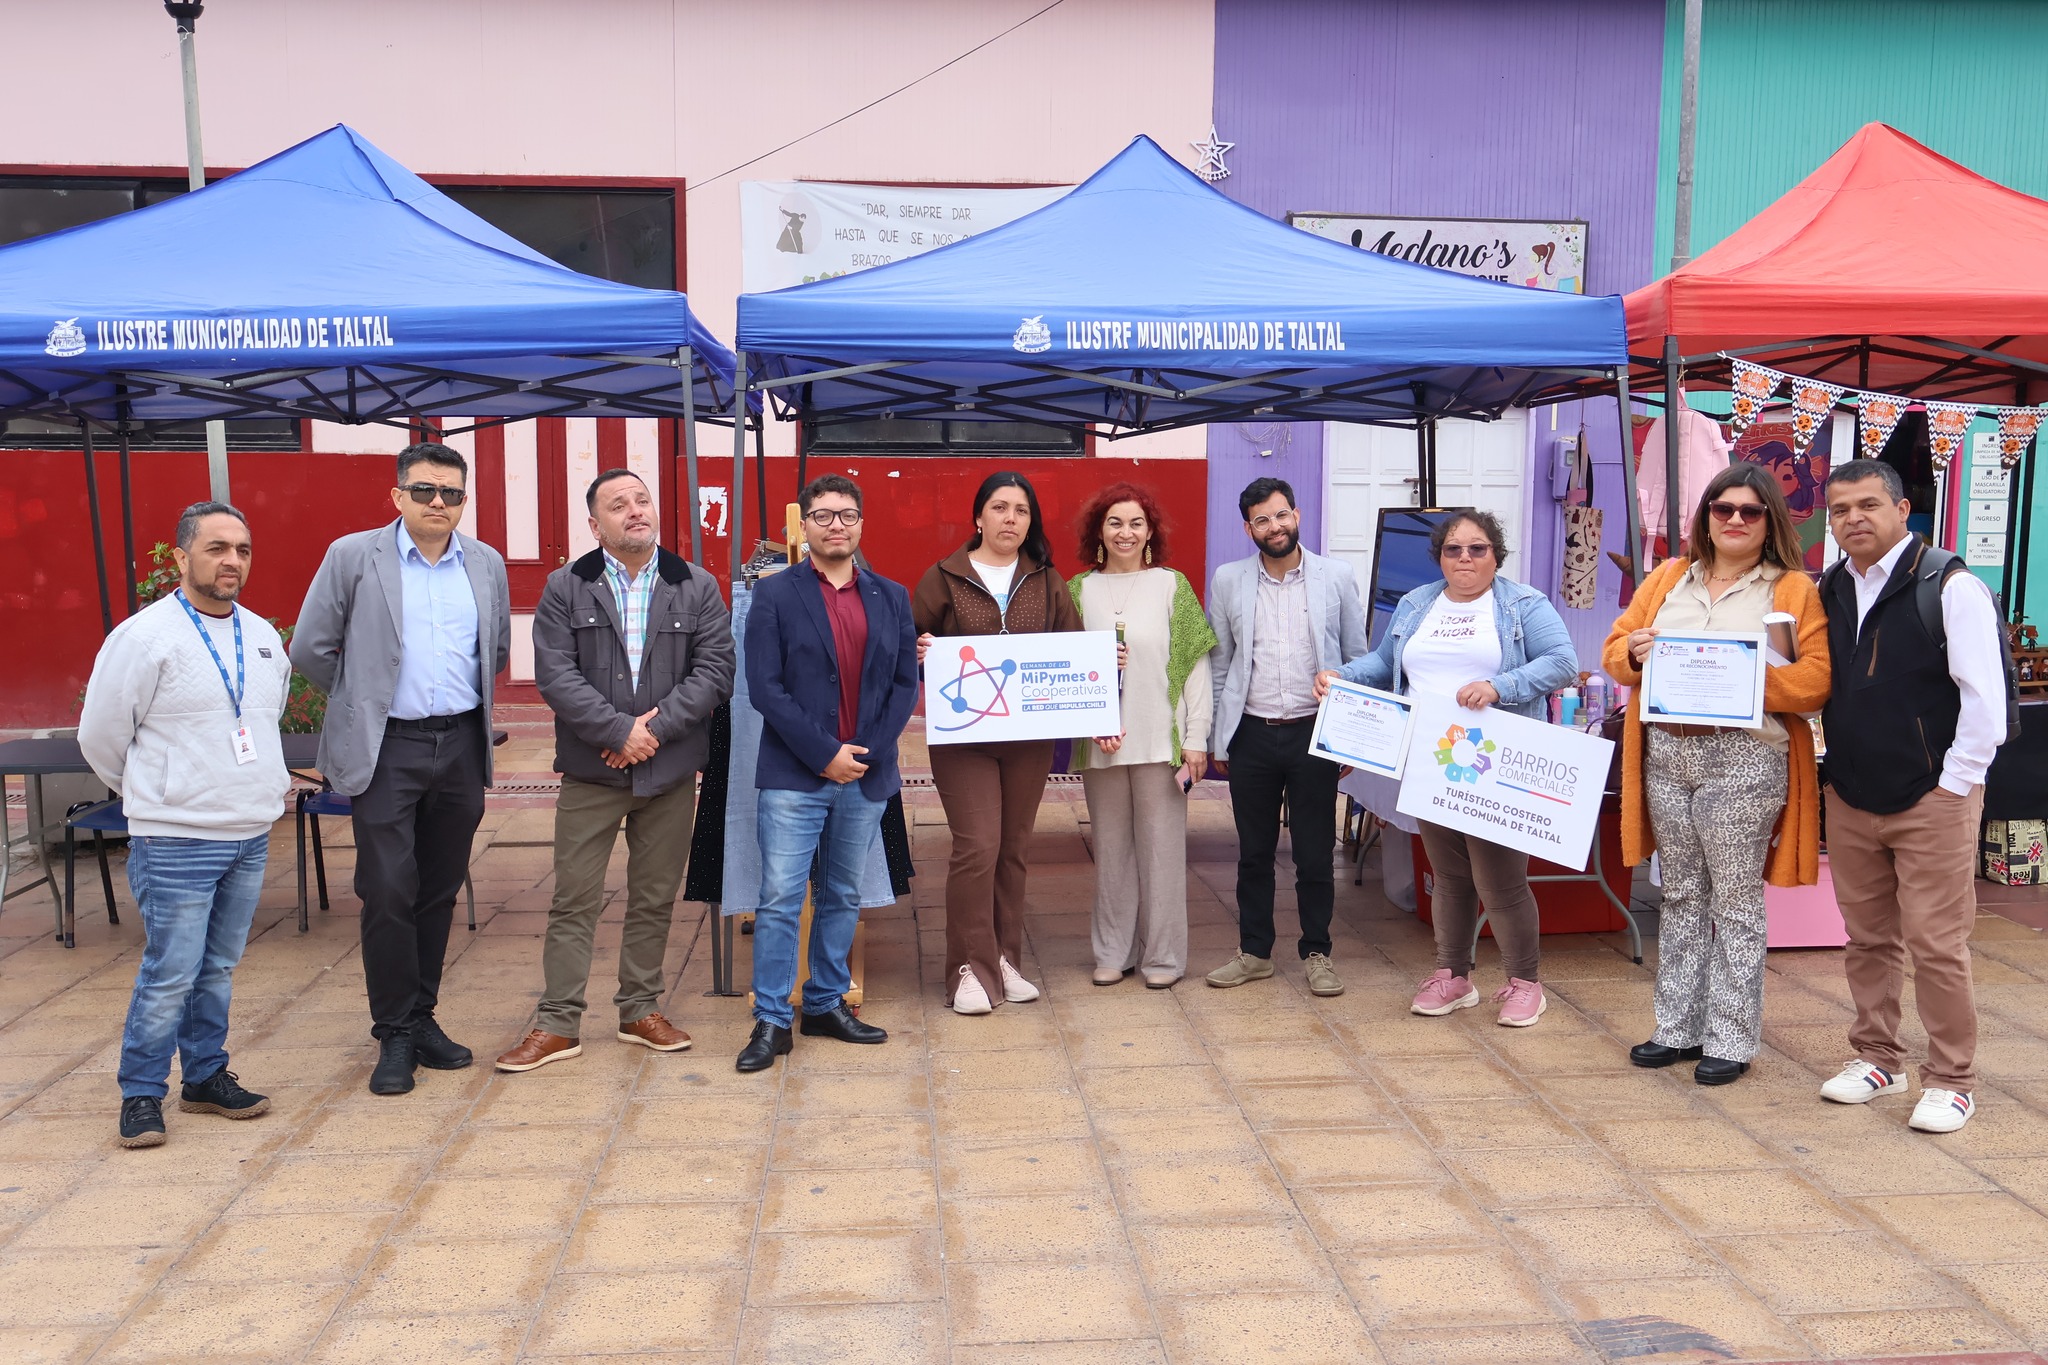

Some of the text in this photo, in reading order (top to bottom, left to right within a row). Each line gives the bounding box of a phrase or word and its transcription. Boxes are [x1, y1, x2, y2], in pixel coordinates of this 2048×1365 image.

[899, 205, 943, 219] SIEMPRE
[952, 207, 972, 221] DAR
[834, 228, 866, 242] HASTA
[878, 229, 899, 243] QUE
[910, 232, 924, 245] SE
[932, 234, 954, 246] NOS
[851, 253, 892, 267] BRAZOS
[97, 315, 394, 351] ILUSTRE MUNICIPALIDAD DE TALTAL
[1137, 321, 1259, 350] MUNICIPALIDAD
[1264, 321, 1285, 351] DE
[1288, 321, 1345, 351] TALTAL
[1021, 671, 1086, 686] MiPymes
[1021, 683, 1108, 700] Cooperativas
[1356, 709, 1377, 719] DIPLOMA
[1500, 747, 1579, 784] BARRIOS
[1498, 766, 1575, 797] COMERCIALES
[1446, 786, 1552, 827] TURÍSTICO COSTERO
[1432, 796, 1562, 845] DE LA COMUNA DE TALTAL
